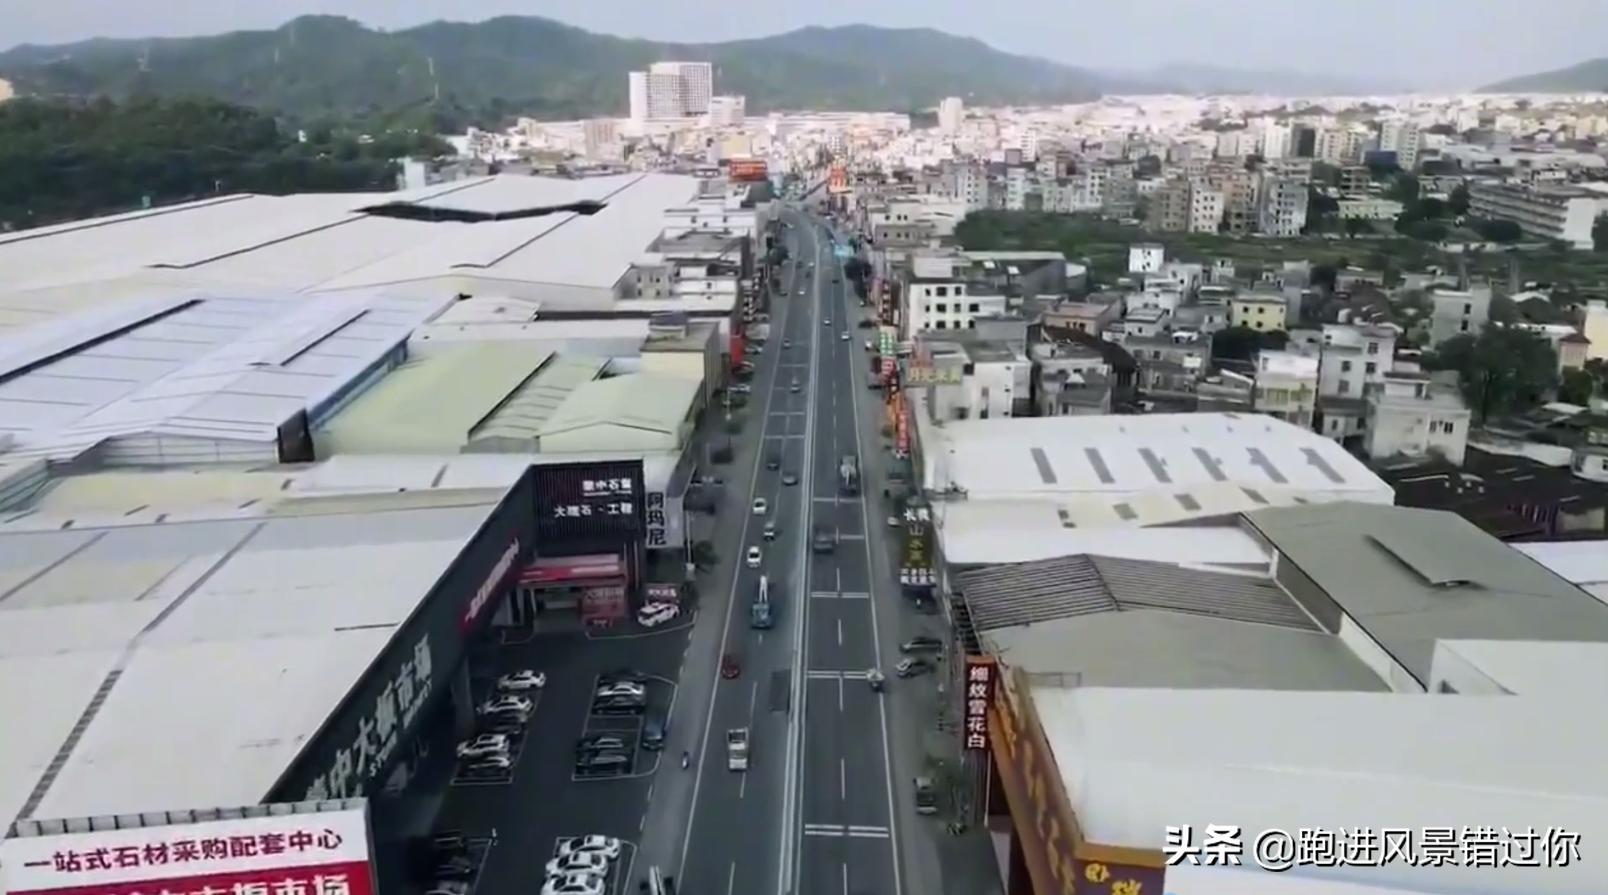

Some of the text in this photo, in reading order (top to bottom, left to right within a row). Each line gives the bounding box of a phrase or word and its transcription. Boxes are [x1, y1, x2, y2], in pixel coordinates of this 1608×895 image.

[646, 492, 667, 546] 阿玛尼
[967, 666, 989, 749] 细纹雪花白
[24, 829, 343, 873] 一站式石材采购配套中心
